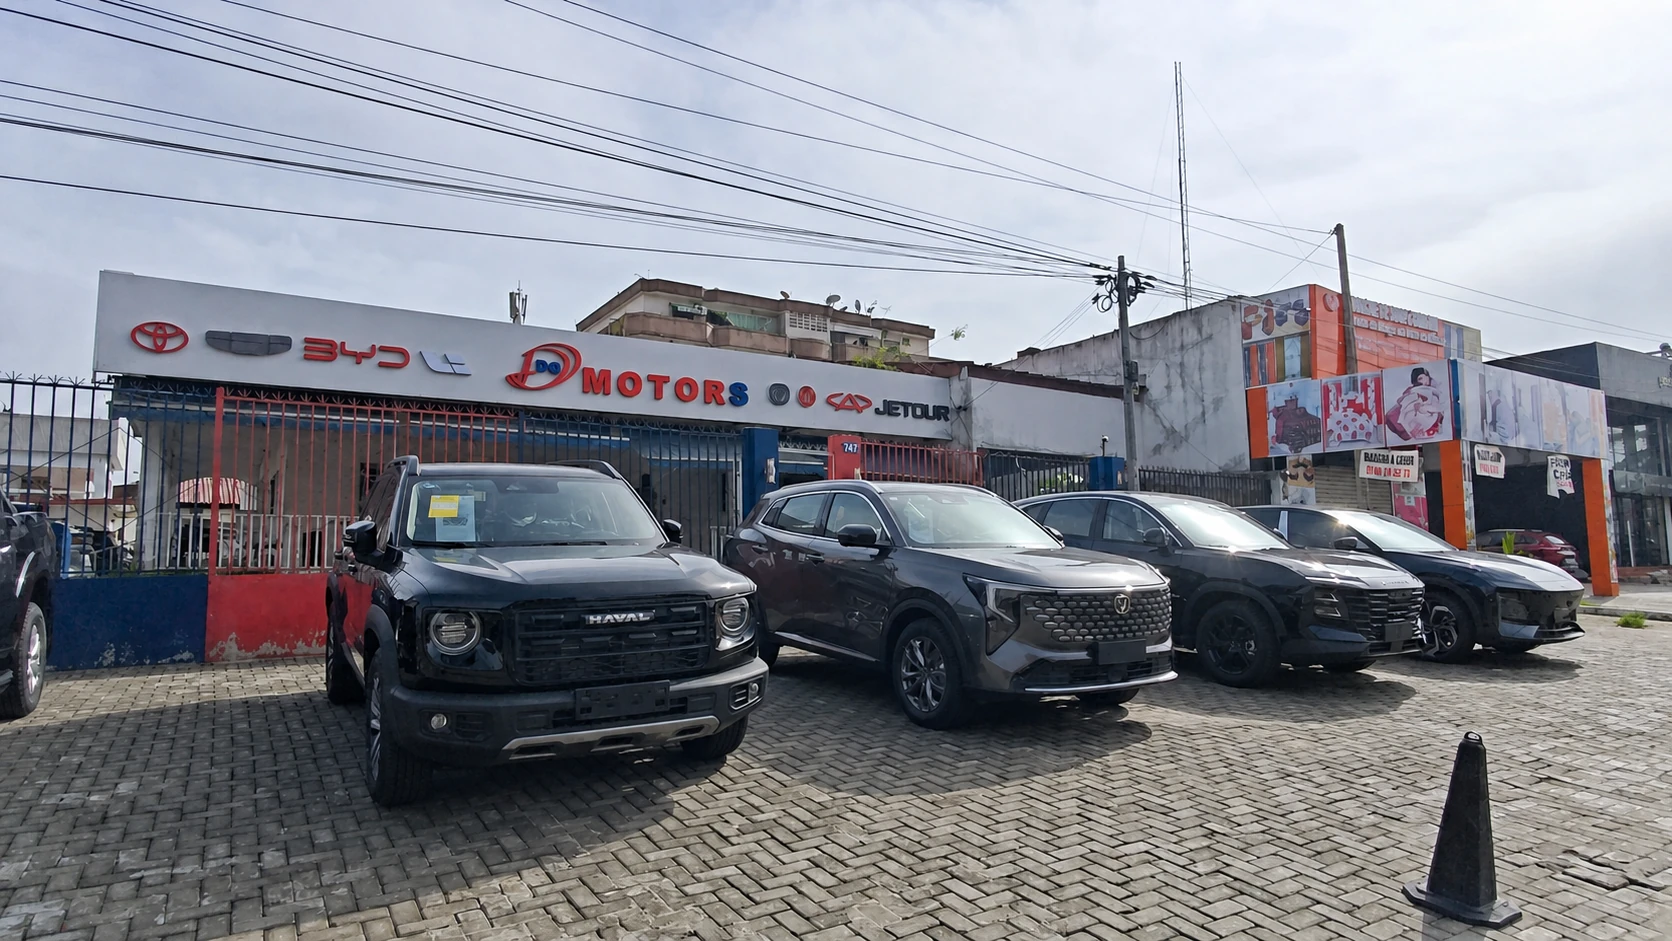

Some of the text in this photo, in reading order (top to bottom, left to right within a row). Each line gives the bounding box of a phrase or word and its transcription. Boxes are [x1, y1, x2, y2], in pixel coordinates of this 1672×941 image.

[304, 337, 410, 369] BYD
[535, 359, 749, 407] DO MOTORS
[874, 399, 950, 422] JETOUR
[843, 443, 858, 453] 747
[589, 612, 651, 625] HAVAL
